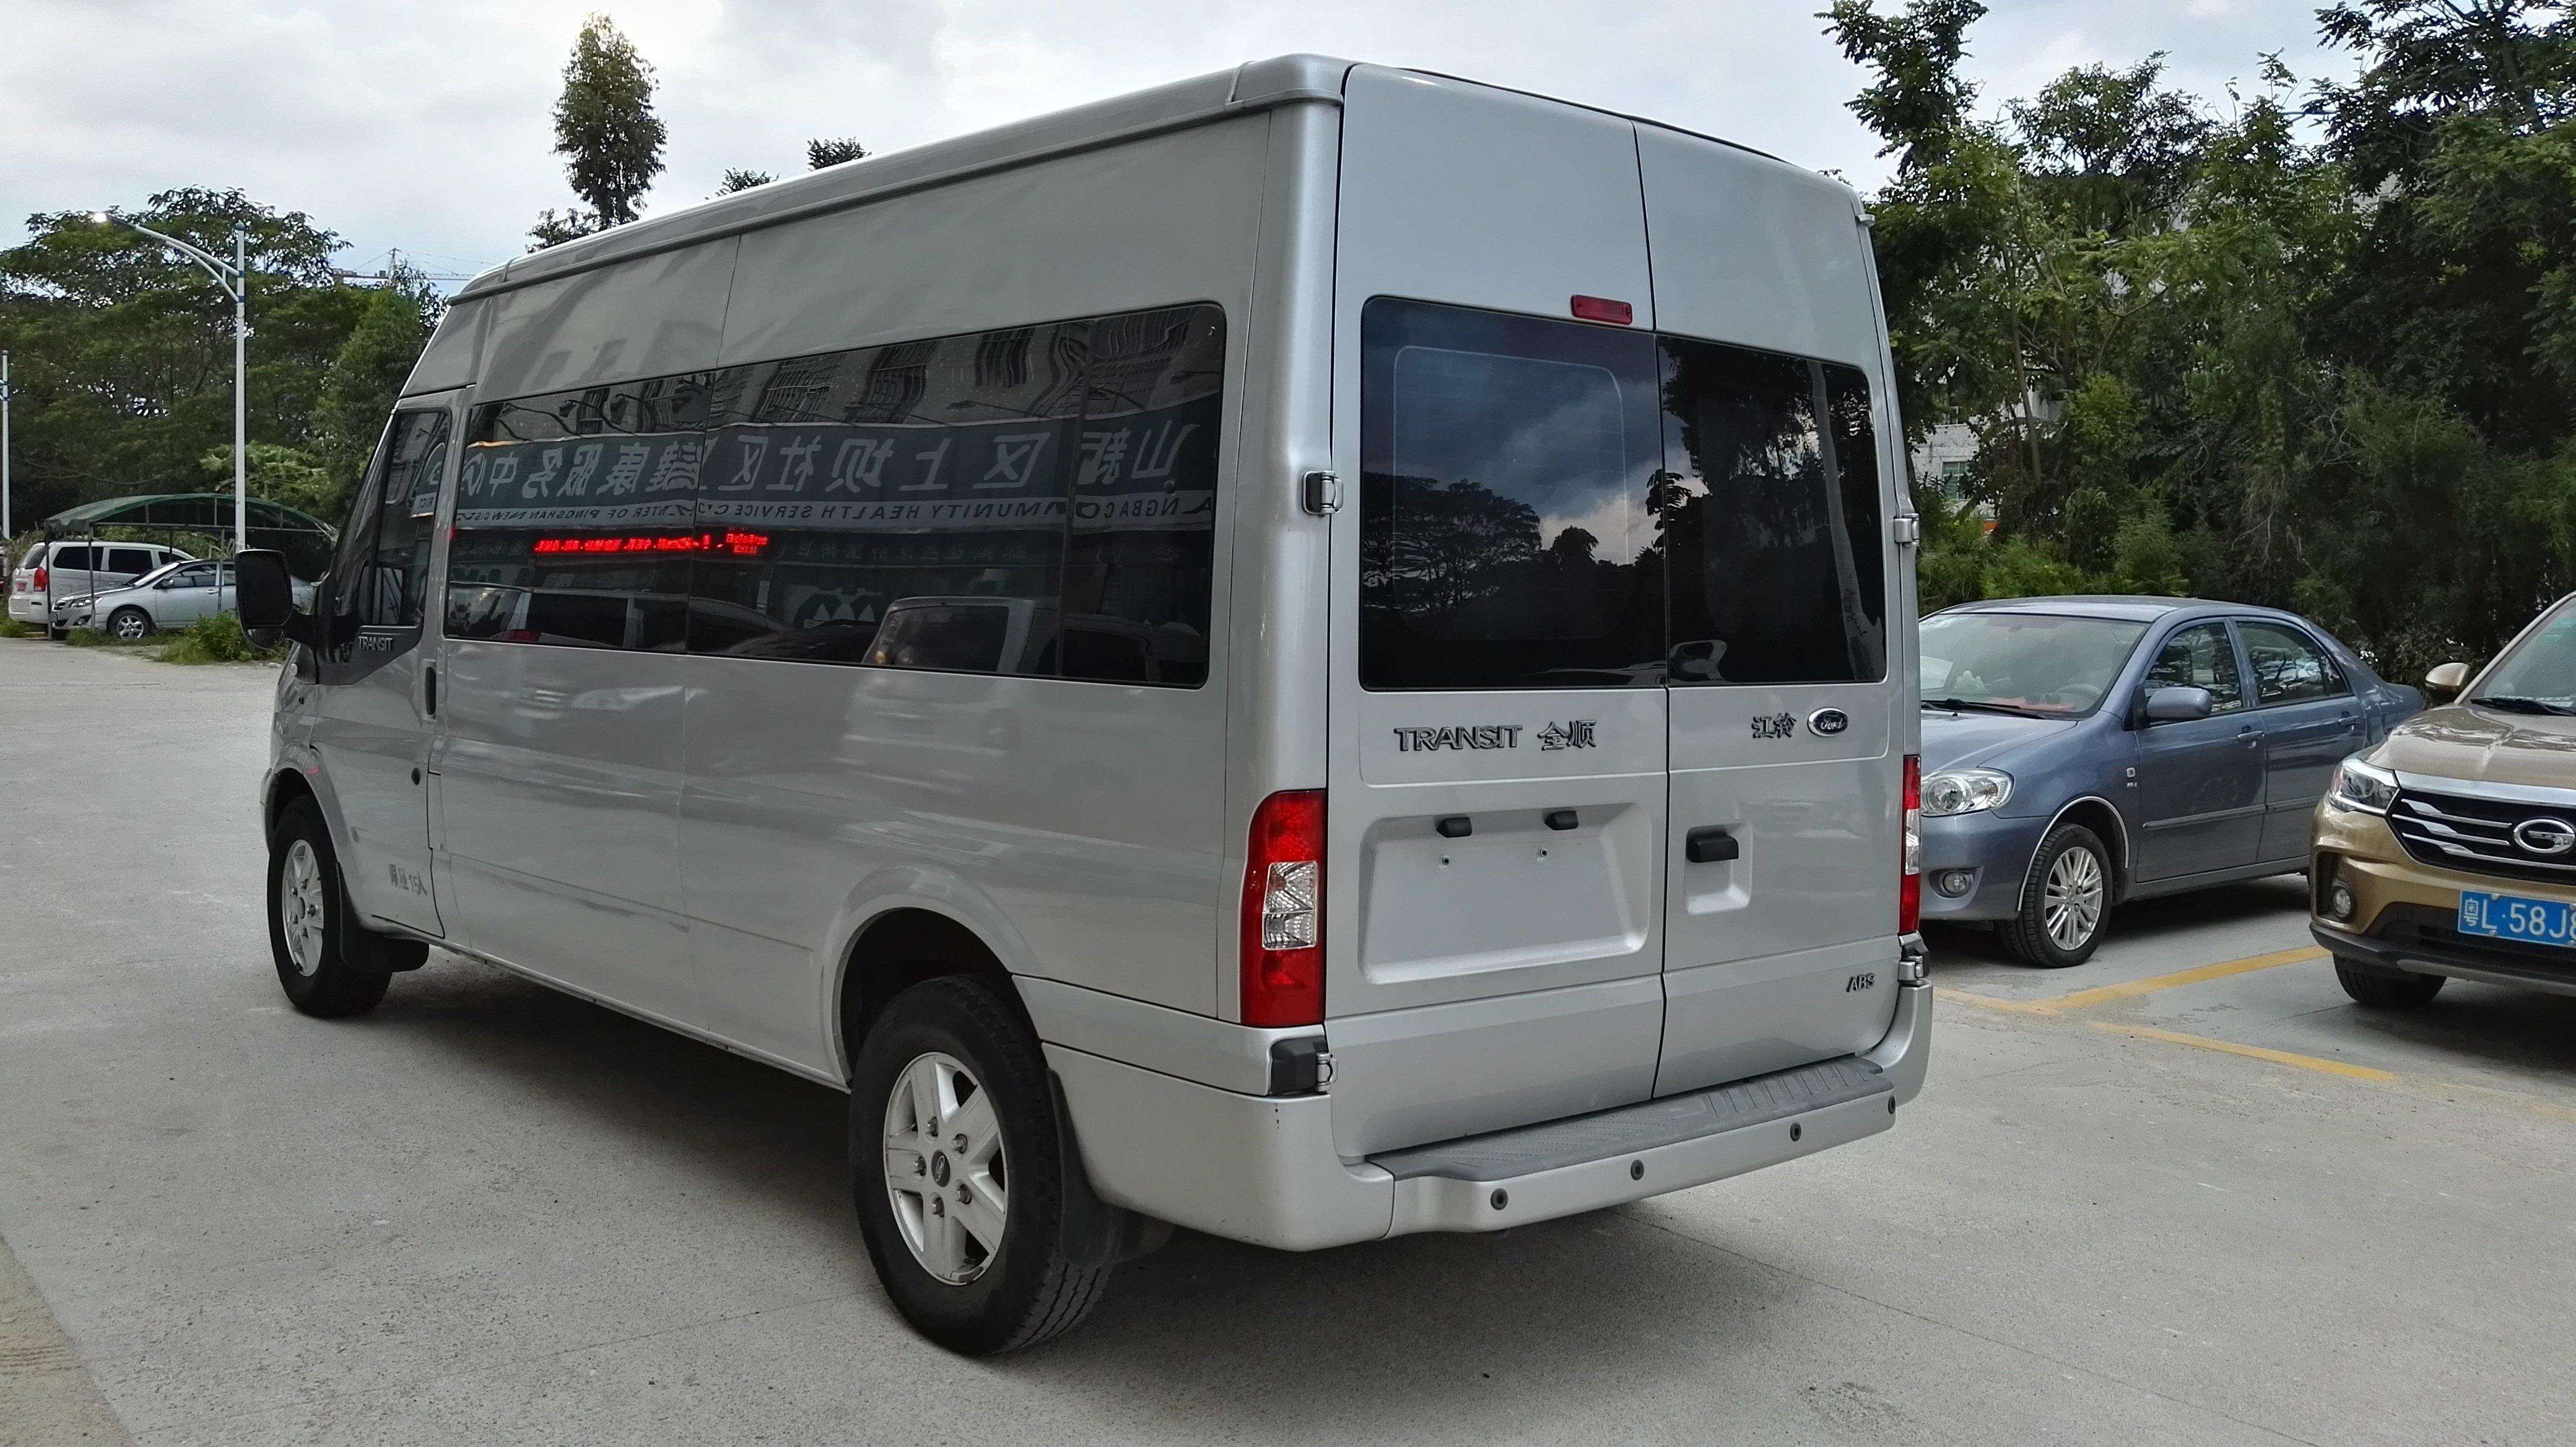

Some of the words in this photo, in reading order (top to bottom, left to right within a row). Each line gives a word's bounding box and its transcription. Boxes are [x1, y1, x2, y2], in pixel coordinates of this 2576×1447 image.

[358, 636, 393, 651] TRANSIT
[1393, 724, 1523, 751] TRANSIT
[1537, 719, 1597, 751] 全顺
[1751, 712, 1797, 739] 江铃
[1846, 973, 1877, 992] ABS
